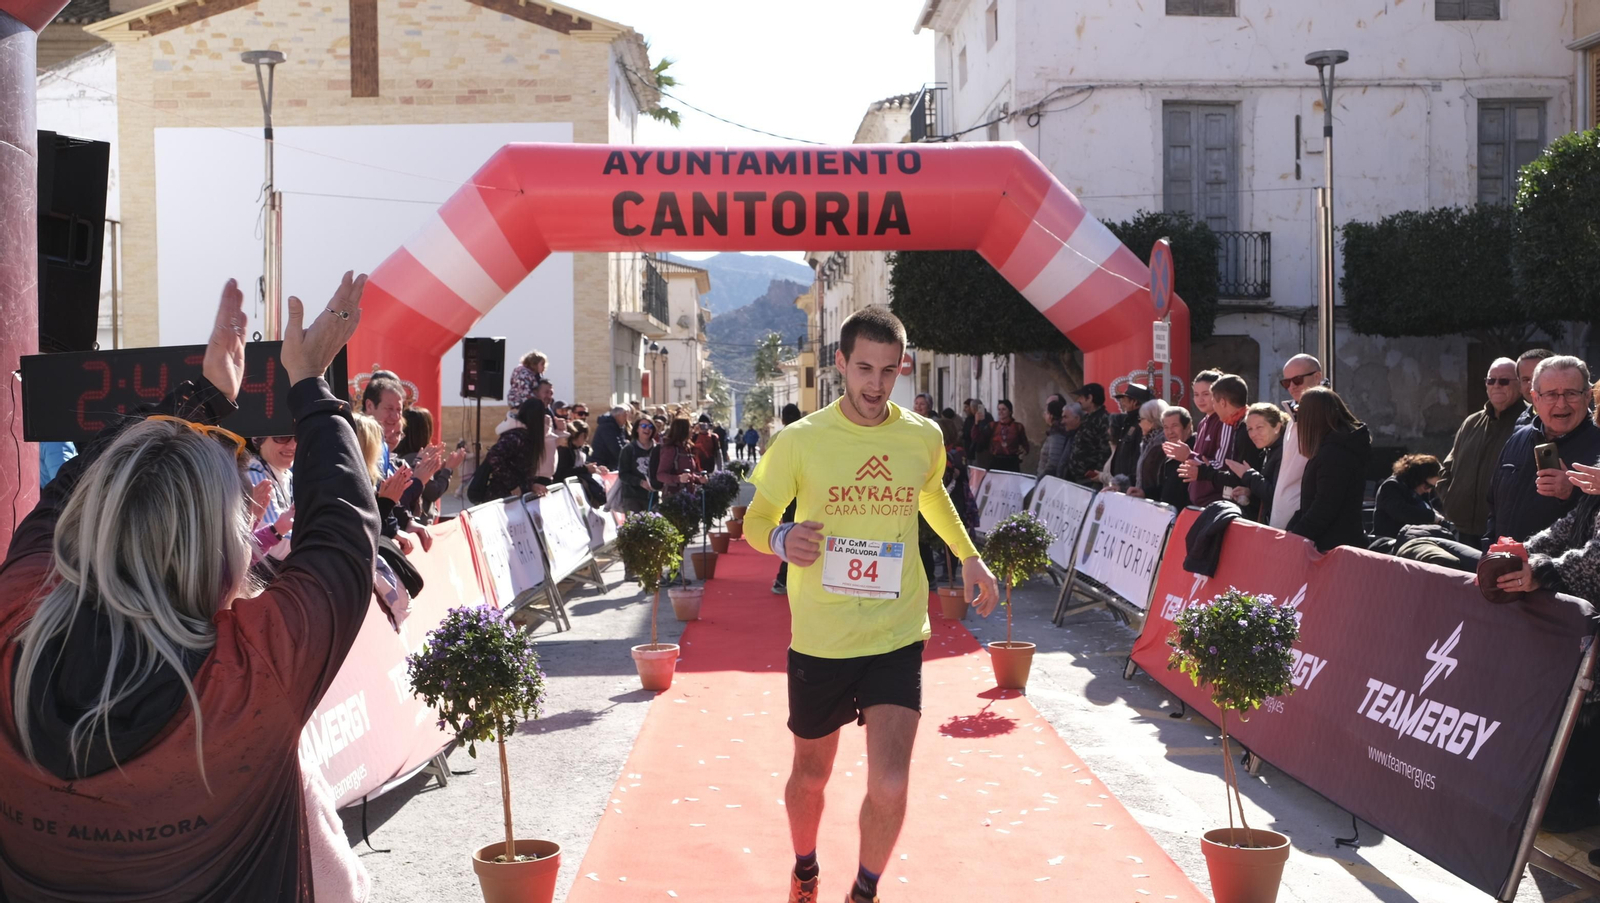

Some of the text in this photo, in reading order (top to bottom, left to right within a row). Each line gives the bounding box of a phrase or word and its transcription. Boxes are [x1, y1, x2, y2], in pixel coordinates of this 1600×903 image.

[602, 150, 922, 175] AYUNTAMIENTO
[611, 190, 912, 237] CANTORIA
[829, 486, 914, 502] SKYRACE
[825, 504, 912, 516] CARAS NORTES
[846, 547, 877, 556] PÓLVORA
[1094, 530, 1154, 581] CANTORIA
[848, 559, 878, 582] 84
[298, 689, 371, 770] AMERGY
[1357, 677, 1502, 761] TEAMERGY
[1368, 745, 1436, 790] www.teamergy.es
[32, 817, 57, 835] DE
[67, 815, 208, 843] ALMANZORA
